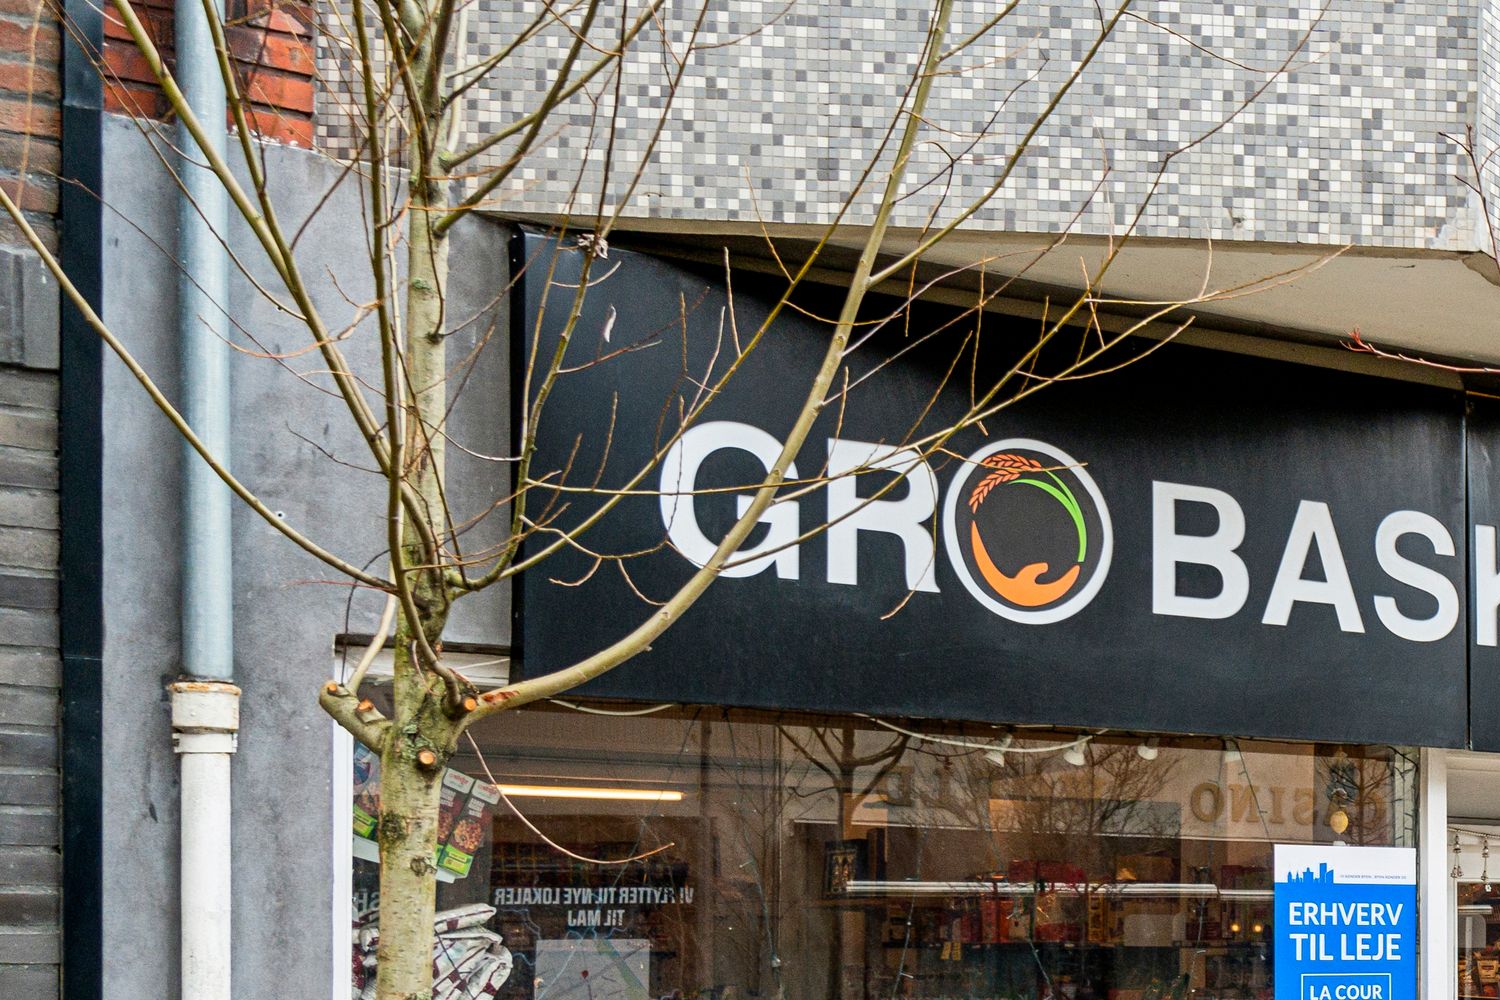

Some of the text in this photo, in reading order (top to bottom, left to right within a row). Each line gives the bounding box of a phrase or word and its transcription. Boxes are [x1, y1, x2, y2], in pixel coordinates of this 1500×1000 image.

[1289, 902, 1404, 926] ERHVERV
[1289, 933, 1402, 961] TIL LEJE
[1310, 984, 1383, 1000] LA COUR
